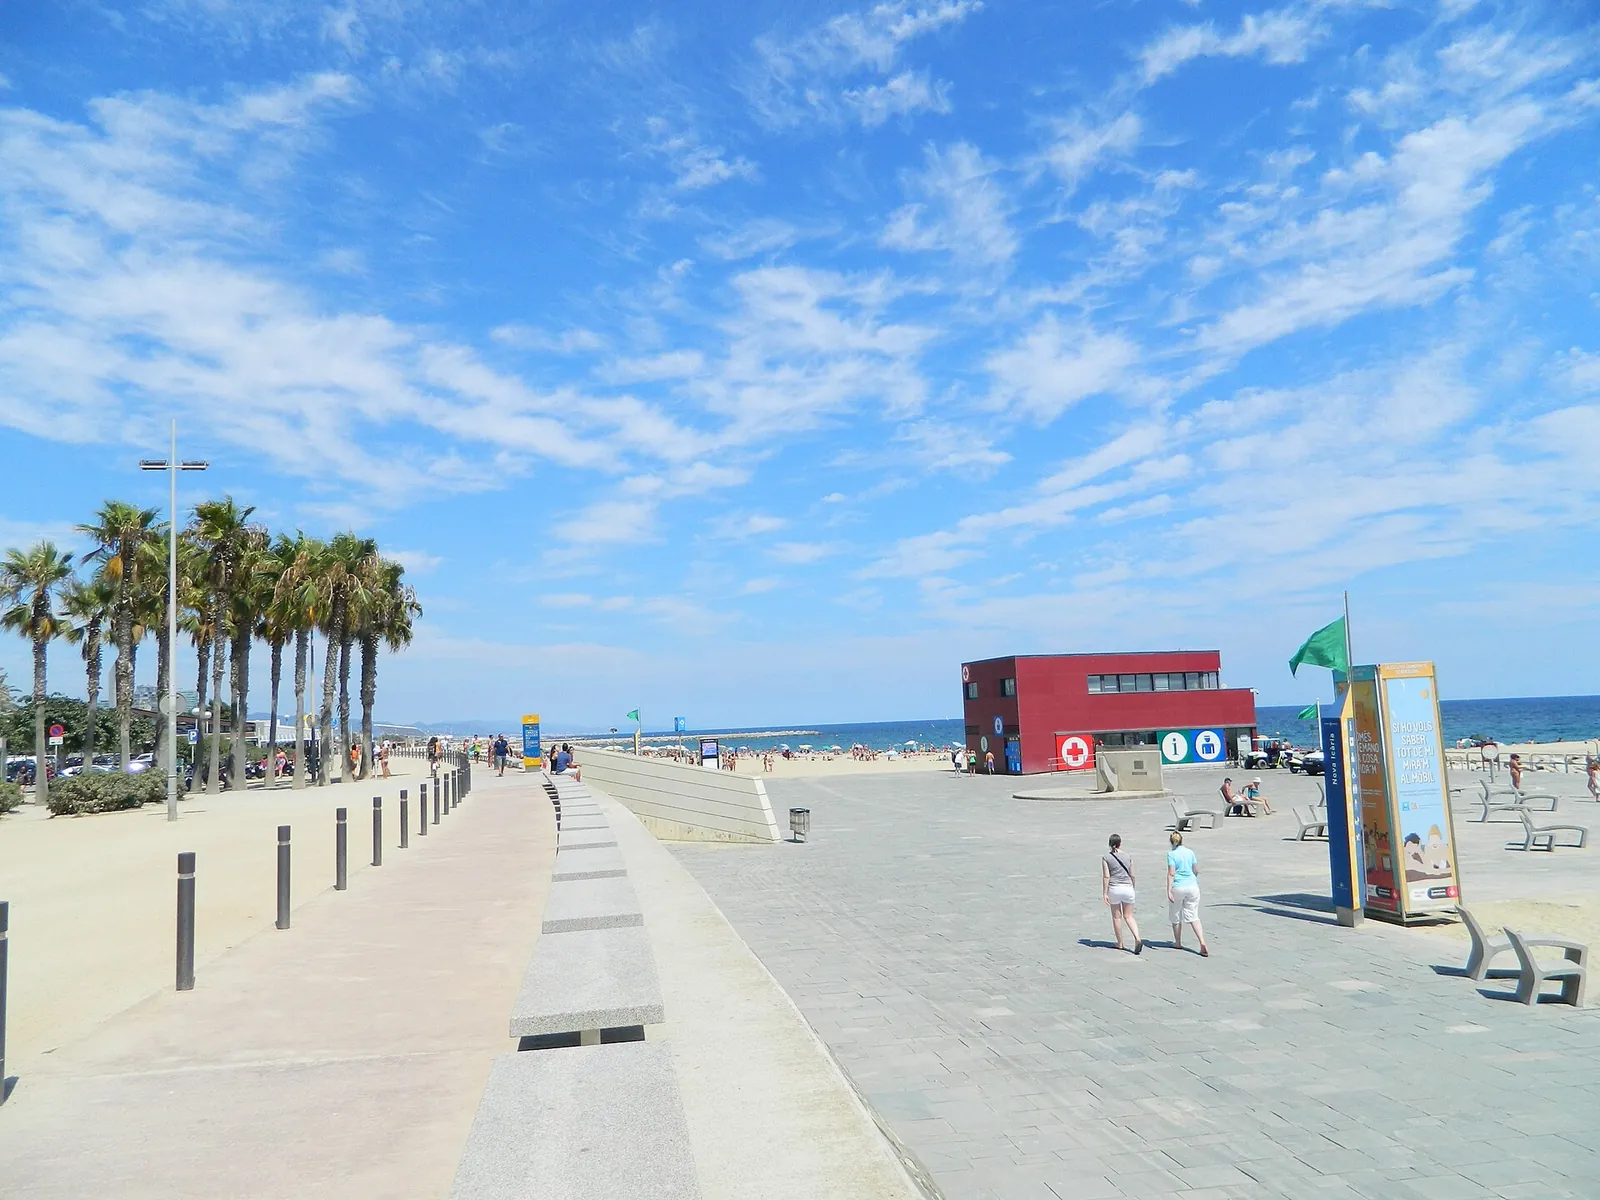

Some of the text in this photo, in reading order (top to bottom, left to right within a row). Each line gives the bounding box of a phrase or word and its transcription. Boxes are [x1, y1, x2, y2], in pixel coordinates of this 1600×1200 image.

[1413, 721, 1432, 732] VOLS
[190, 732, 196, 740] P
[1401, 734, 1426, 746] SABER
[1396, 747, 1412, 758] TOT
